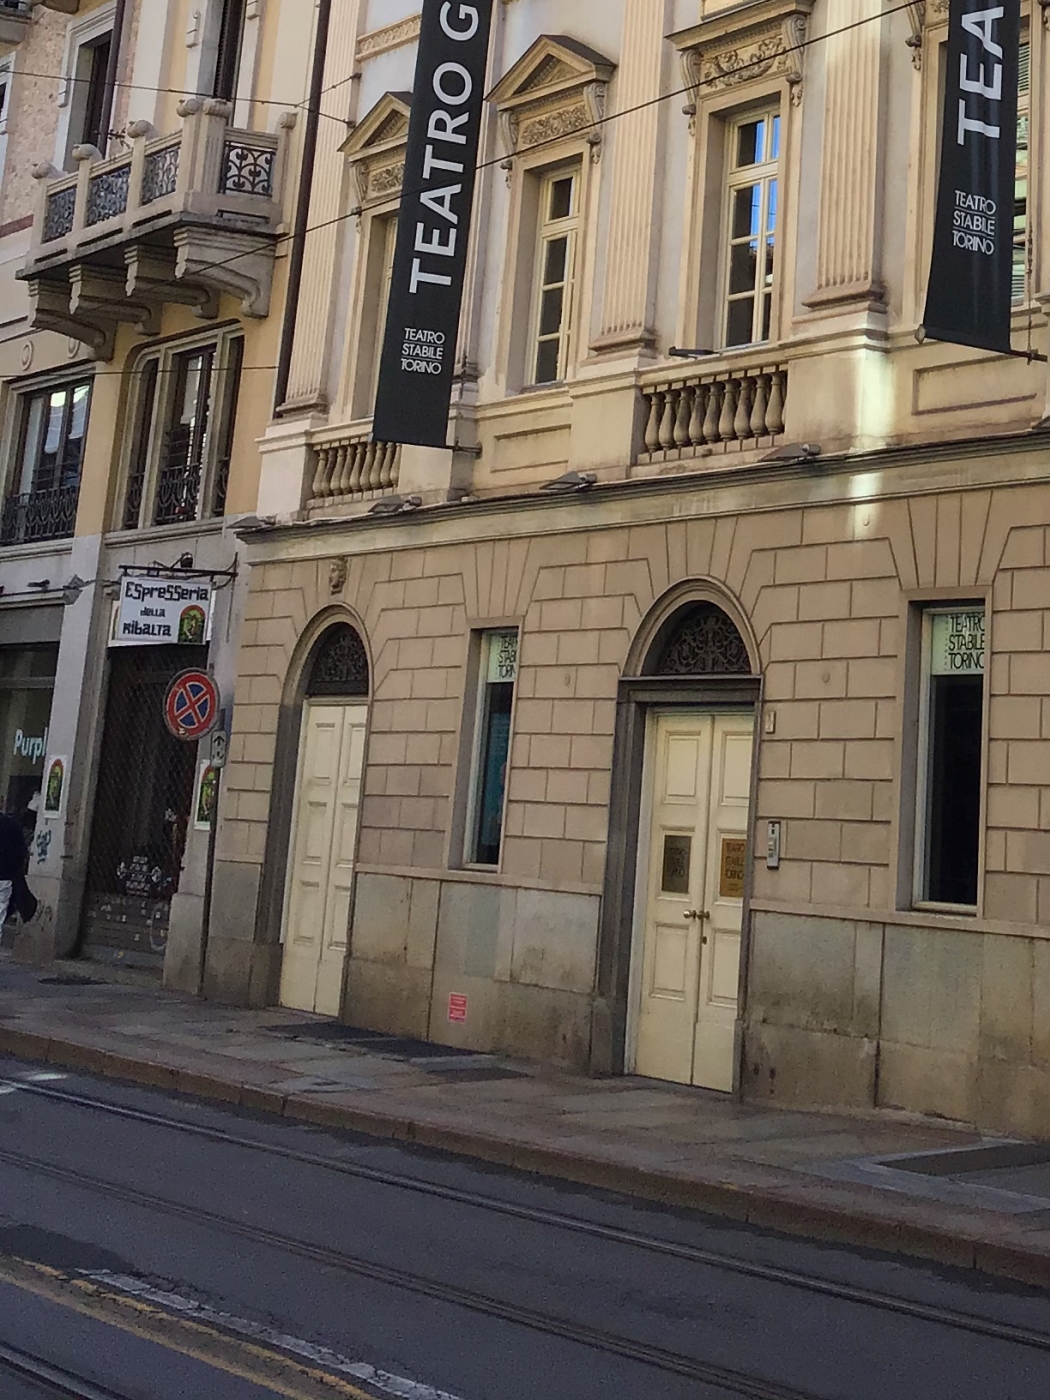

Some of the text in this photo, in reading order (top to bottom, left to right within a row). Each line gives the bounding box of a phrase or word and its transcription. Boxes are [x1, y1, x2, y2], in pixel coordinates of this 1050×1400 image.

[408, 61, 473, 295] TEATRO
[954, 189, 997, 215] TEATRO
[952, 210, 996, 236] STABILE
[951, 229, 995, 255] TORINO
[404, 327, 445, 344] TEATRO
[401, 343, 444, 360] STABILE
[400, 358, 442, 375] TORINO
